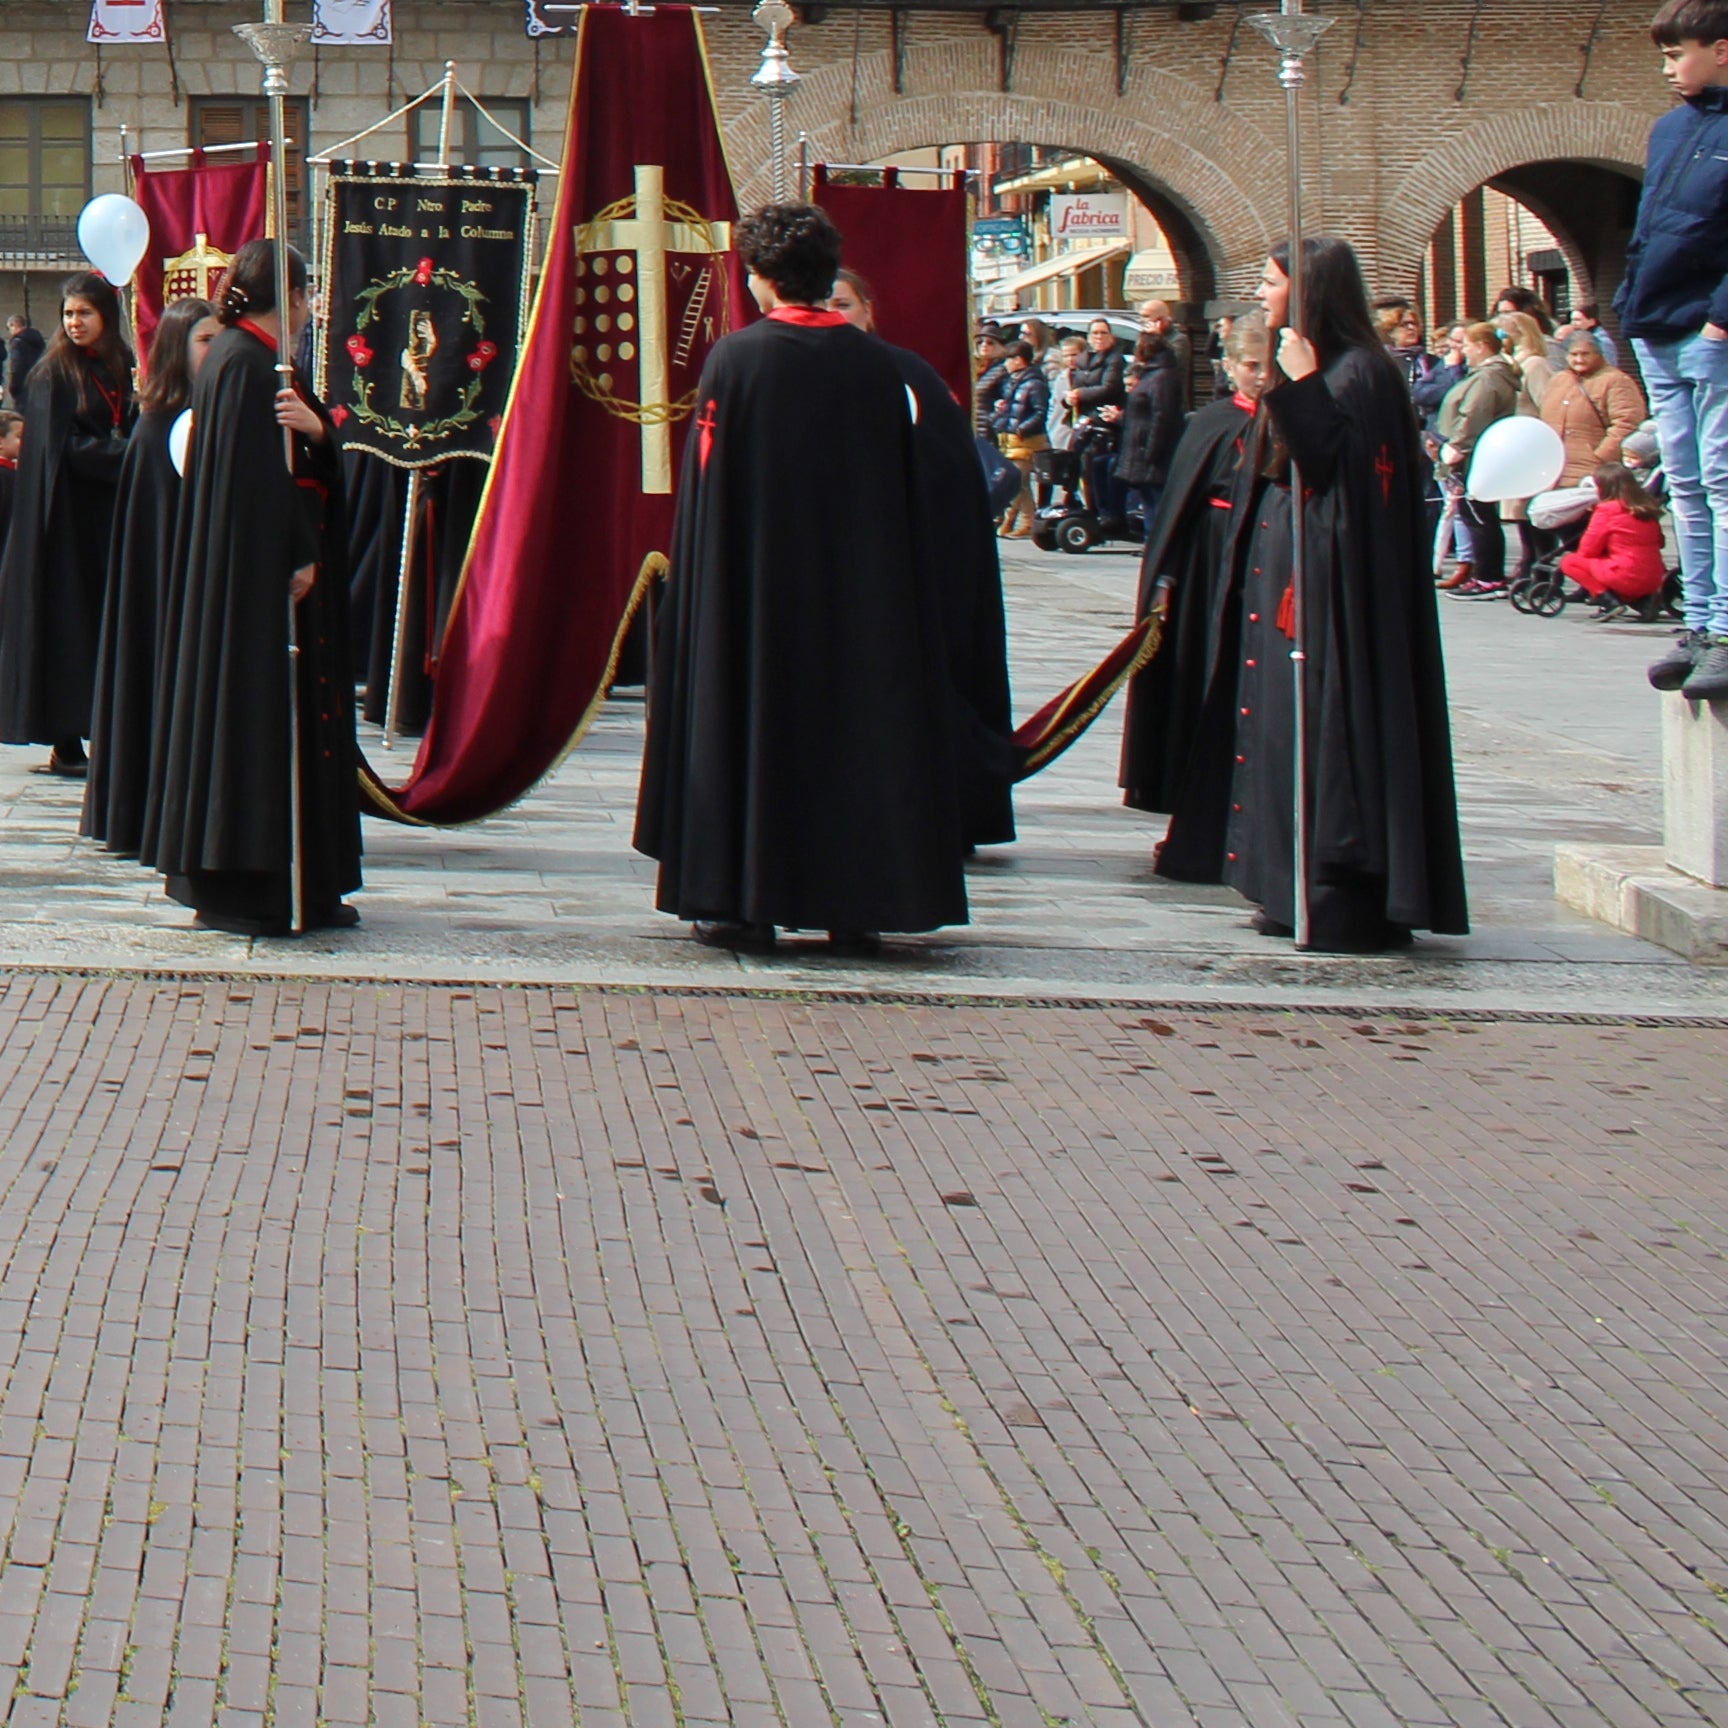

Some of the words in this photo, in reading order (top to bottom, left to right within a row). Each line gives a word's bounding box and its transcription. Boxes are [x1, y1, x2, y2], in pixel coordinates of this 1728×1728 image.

[461, 200, 494, 214] Padre
[1076, 198, 1089, 210] la
[1057, 205, 1120, 233] fabrica
[344, 220, 373, 234] Jesús
[378, 223, 413, 238] Atado
[420, 227, 430, 238] a
[438, 224, 451, 239] la
[460, 225, 515, 240] Columna
[1127, 273, 1163, 286] PRECIO
